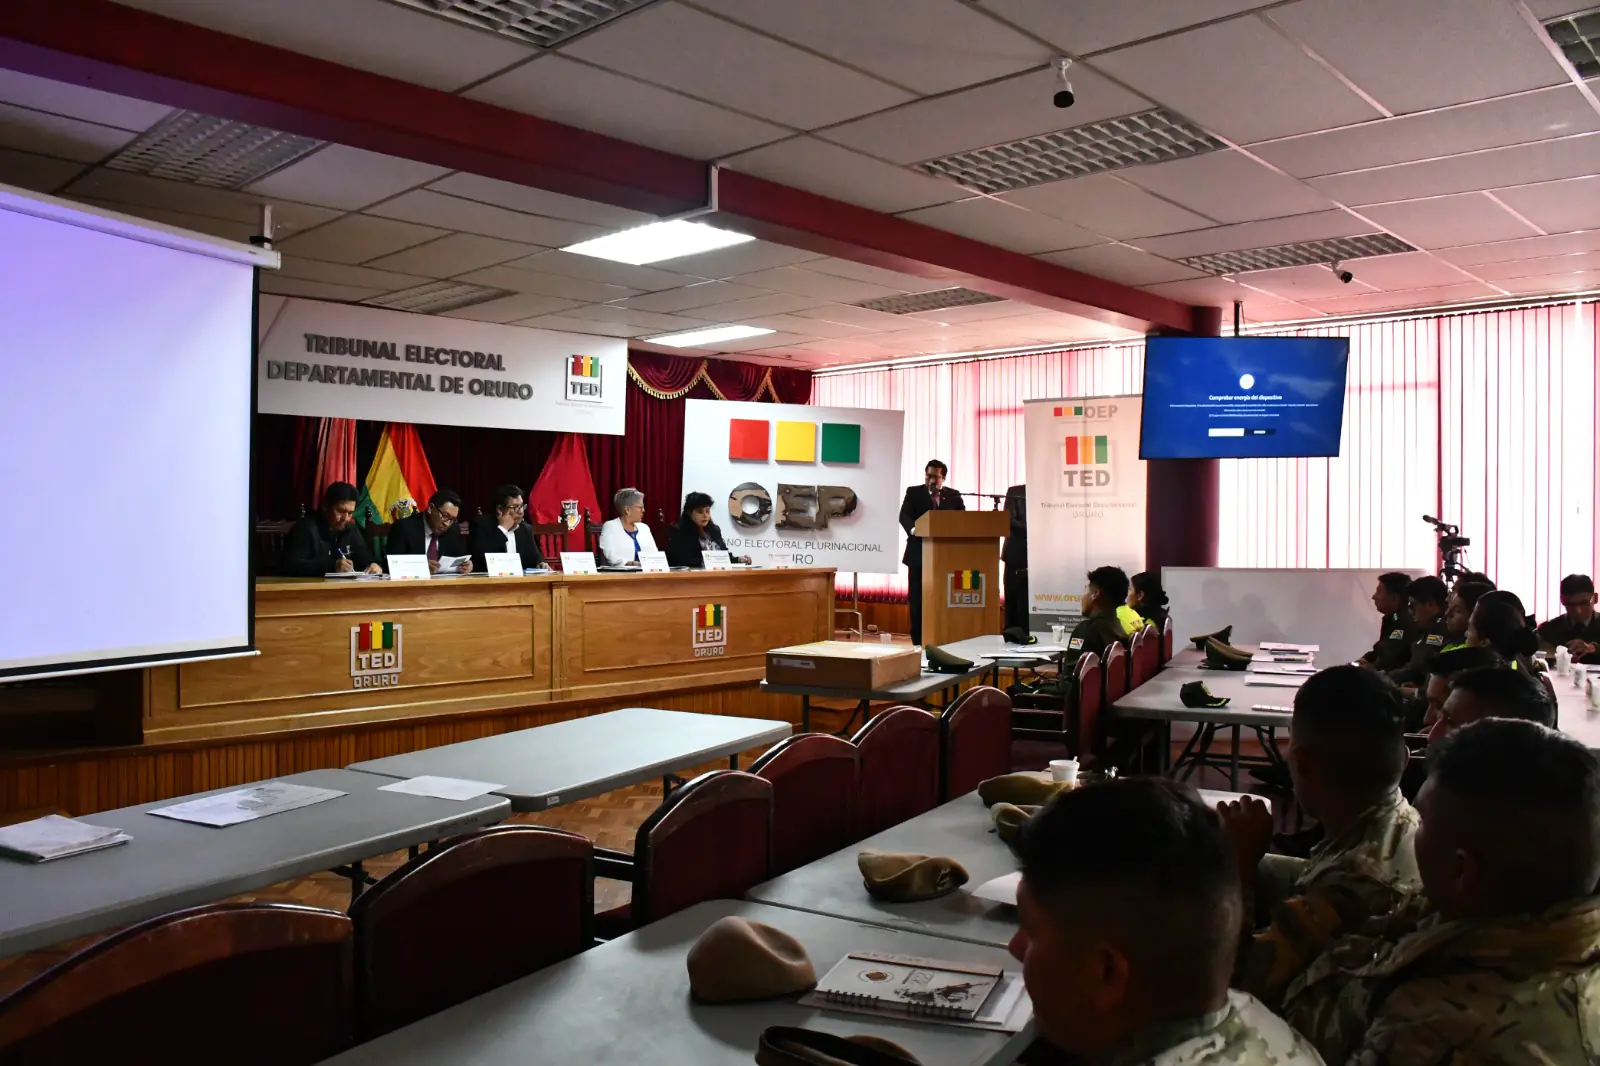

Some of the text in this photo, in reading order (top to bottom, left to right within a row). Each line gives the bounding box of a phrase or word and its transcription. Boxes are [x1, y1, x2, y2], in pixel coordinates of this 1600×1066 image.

[304, 333, 505, 371] TRIBUNAL ELECTORAL
[267, 360, 533, 400] DEPARTAMENTAL DE ORURO
[570, 381, 600, 397] TED
[1084, 405, 1118, 419] OEP
[1063, 470, 1110, 488] TED
[728, 482, 858, 531] OEP
[727, 538, 883, 552] NO ELECTORAL PLURINACIONAL
[953, 592, 980, 604] TED
[1034, 593, 1081, 603] www.oru
[697, 628, 722, 643] TED
[694, 646, 725, 657] ORURO
[358, 652, 395, 669] TED
[353, 673, 399, 688] ORURO
